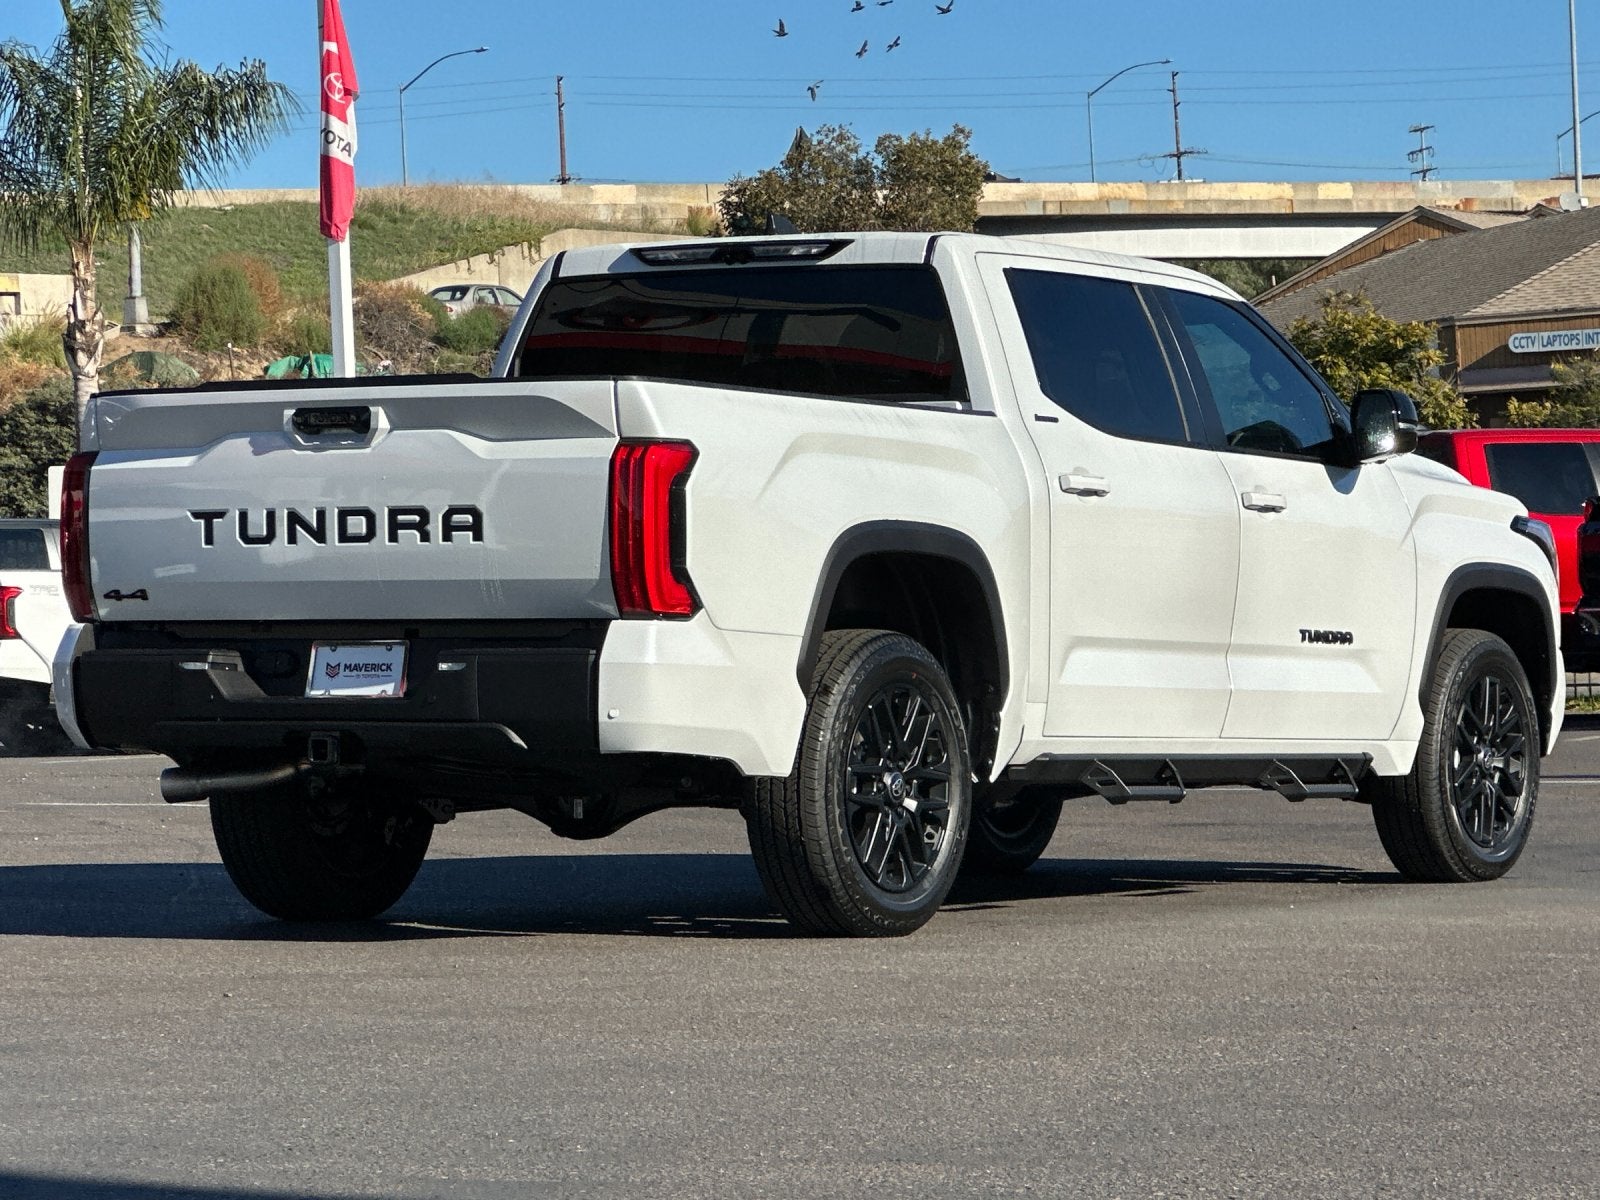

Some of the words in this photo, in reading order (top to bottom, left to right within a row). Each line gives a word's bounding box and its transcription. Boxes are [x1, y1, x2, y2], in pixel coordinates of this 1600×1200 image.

[1512, 335, 1537, 349] CCTV
[1541, 333, 1580, 348] LAPTOPS
[186, 504, 484, 548] TUNDRA
[1299, 628, 1354, 645] TUNDRA
[343, 662, 393, 673] MAVERICK
